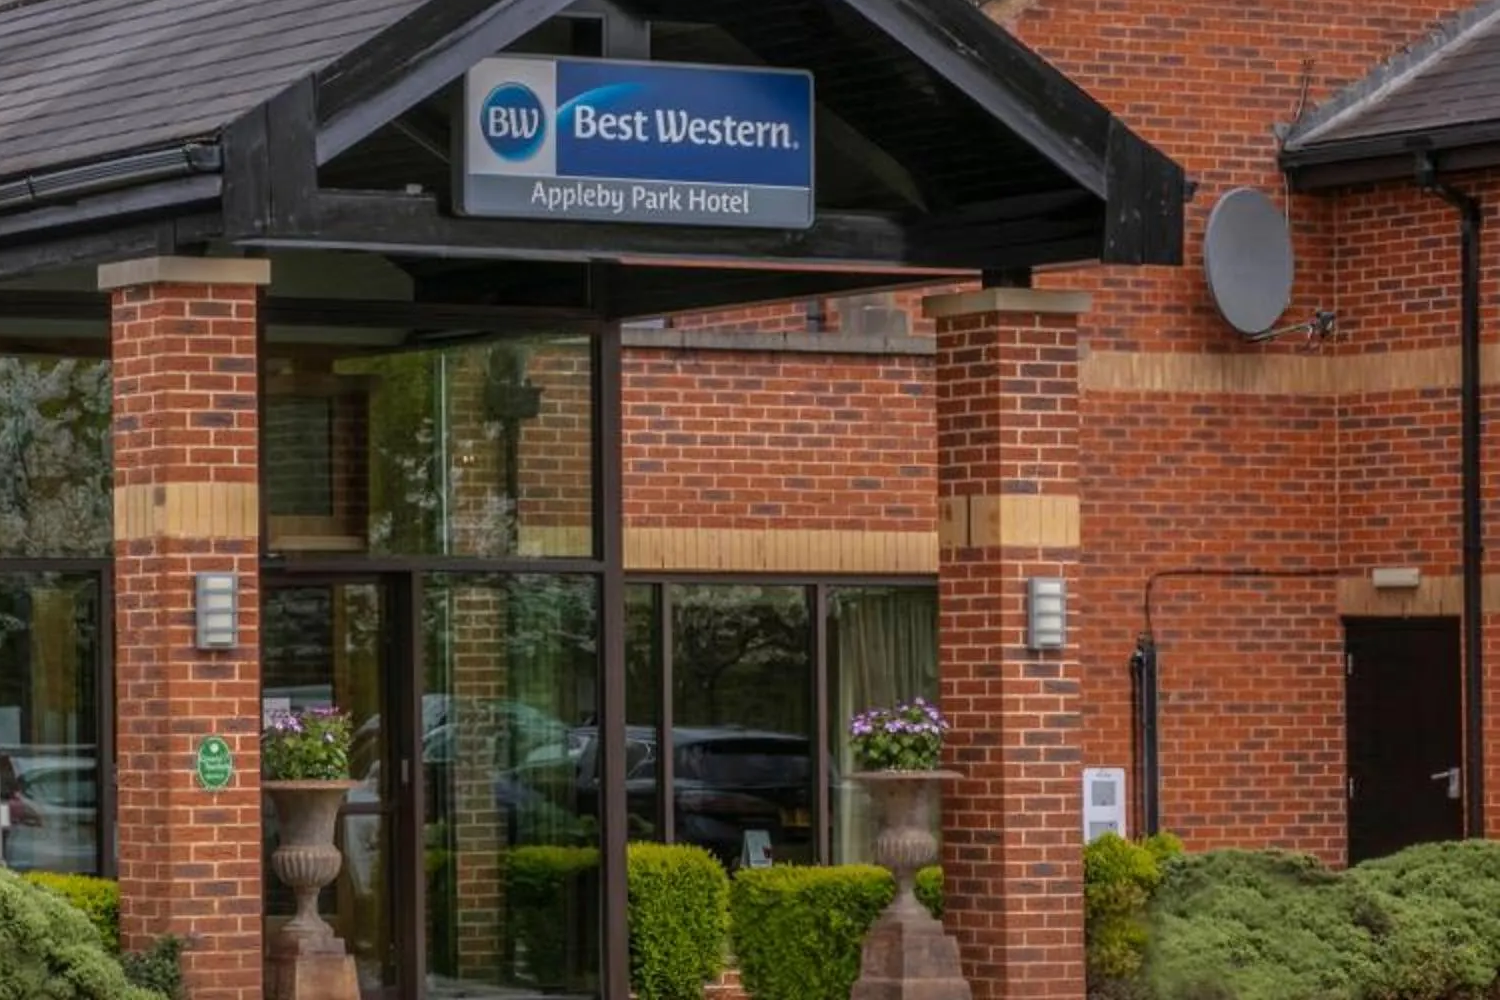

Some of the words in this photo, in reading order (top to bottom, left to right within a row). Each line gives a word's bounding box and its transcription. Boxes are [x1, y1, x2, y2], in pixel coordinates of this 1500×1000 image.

[488, 105, 540, 139] BW
[574, 104, 649, 142] Best
[531, 181, 624, 213] Appleby
[632, 185, 682, 212] Park
[689, 189, 750, 214] Hotel
